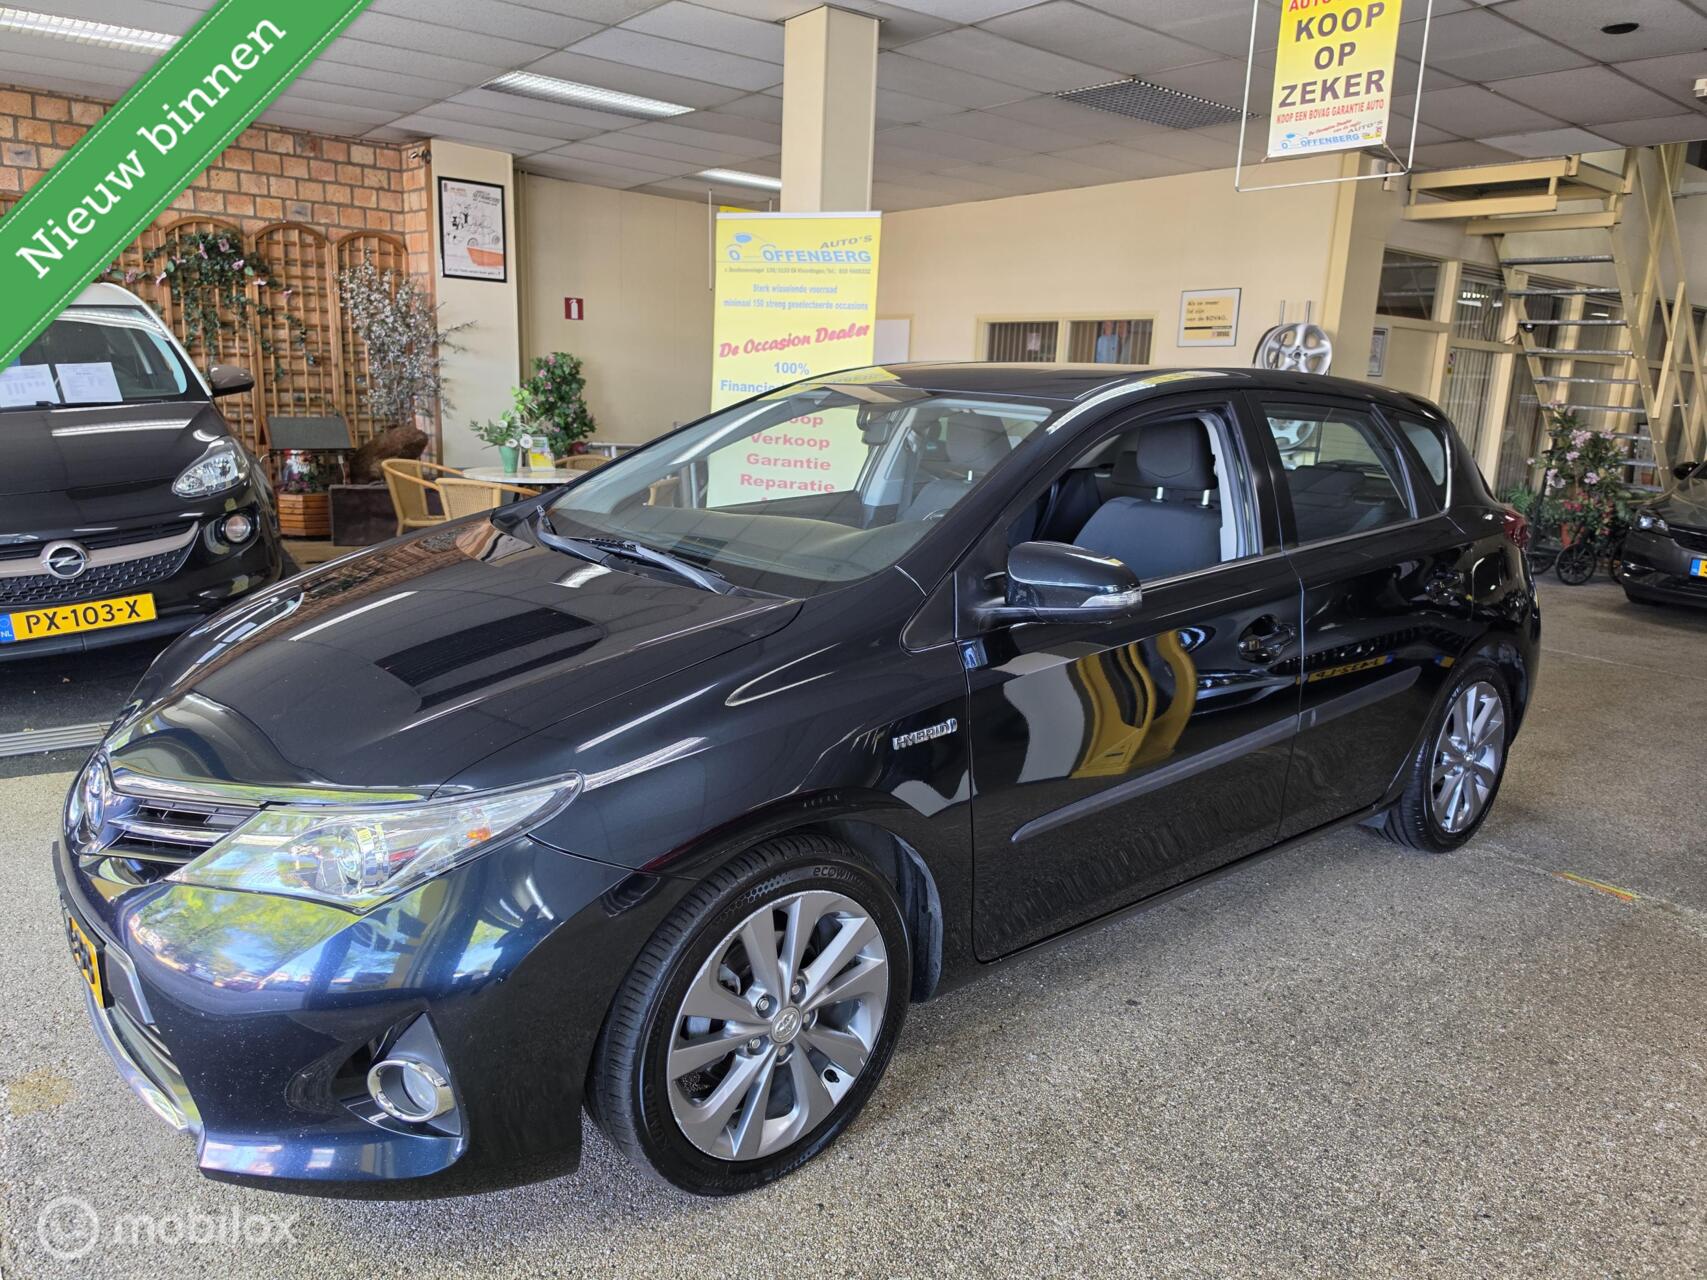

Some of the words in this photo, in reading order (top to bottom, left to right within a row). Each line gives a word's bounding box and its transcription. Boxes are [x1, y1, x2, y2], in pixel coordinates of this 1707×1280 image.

[1295, 2, 1385, 42] KOOP
[1314, 41, 1357, 70] OP
[1278, 69, 1385, 108] ZEKER
[1276, 112, 1294, 124] KOOP
[1295, 110, 1307, 121] EEN
[1308, 107, 1330, 120] BOVAG
[1331, 102, 1365, 117] GARANTIE
[1366, 98, 1385, 112] AUTO
[1300, 133, 1360, 148] OFFENBERG
[819, 234, 873, 249] AUTO'S
[762, 249, 872, 263] OFFENBERG
[719, 342, 740, 358] De
[743, 333, 812, 355] Occasion
[815, 323, 871, 344] Dealer
[773, 361, 810, 376] 100%
[751, 432, 830, 450] Verkoop
[746, 452, 832, 471] Garantie
[740, 473, 835, 492] Reparatie
[25, 599, 141, 634] PX-103-X
[892, 718, 958, 751] HYBRID
